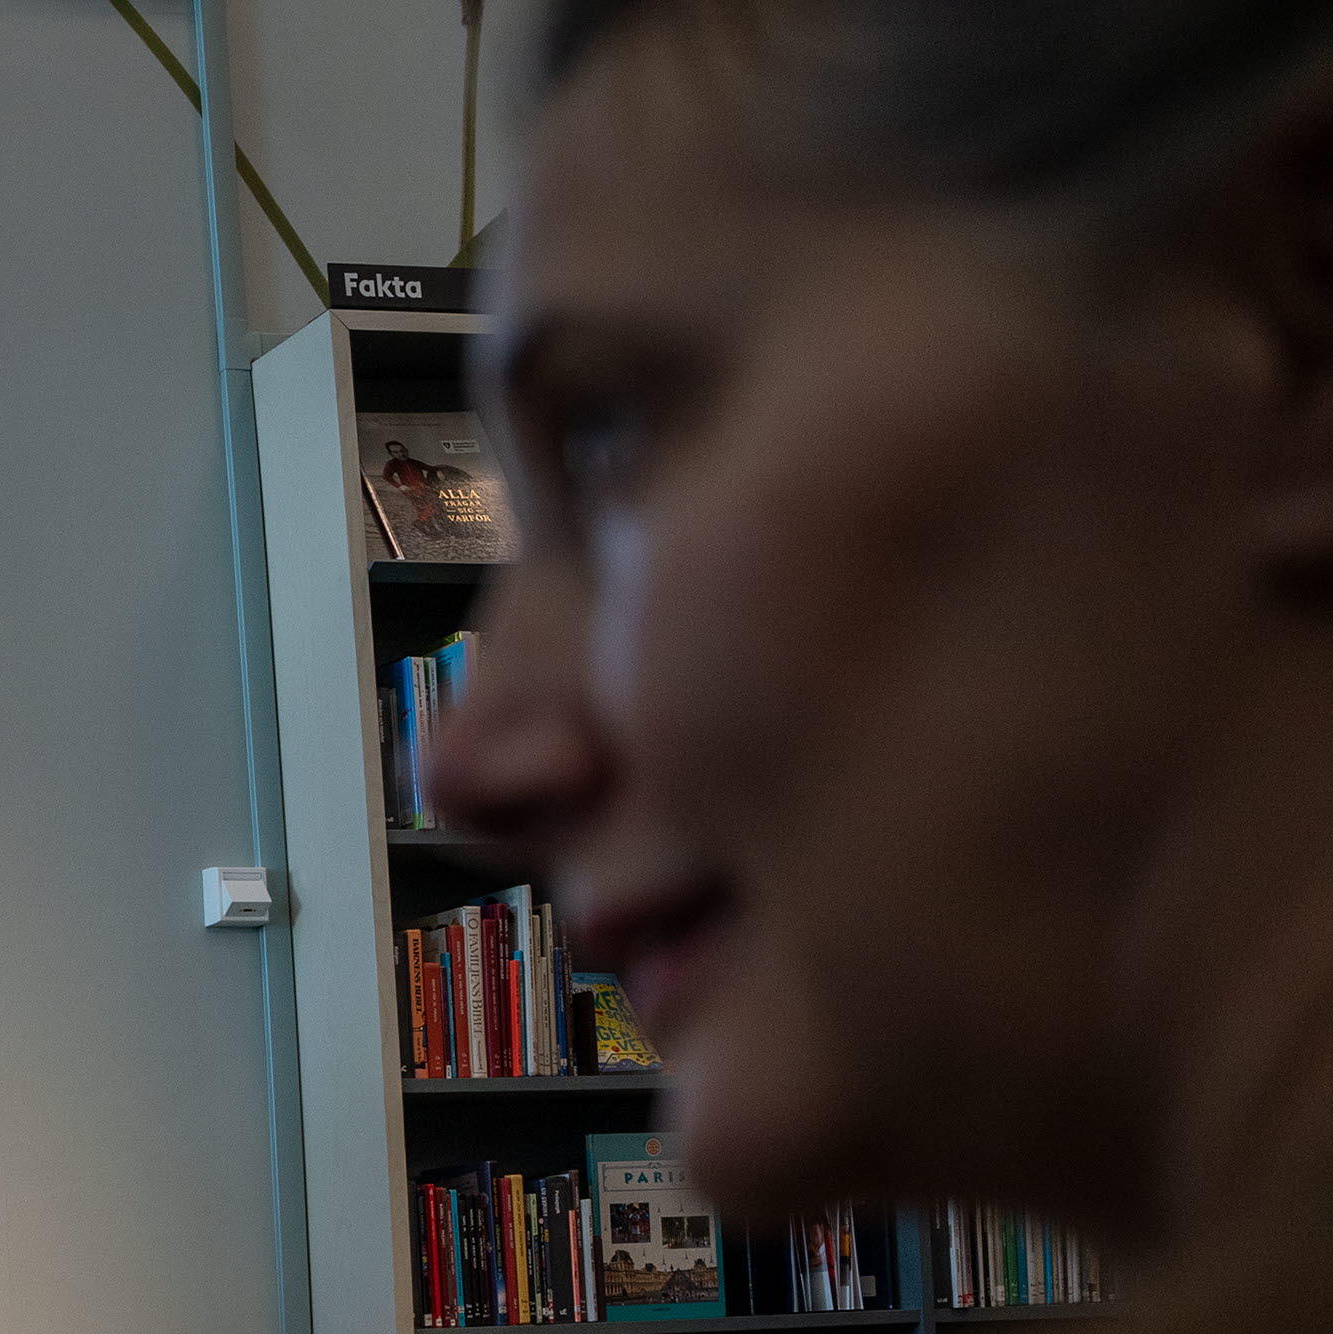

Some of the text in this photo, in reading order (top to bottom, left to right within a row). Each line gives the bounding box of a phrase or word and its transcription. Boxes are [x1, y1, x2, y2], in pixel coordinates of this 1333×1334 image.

[343, 272, 423, 299] Fakta
[438, 489, 481, 499] ALLA
[412, 938, 423, 1014] BARNENS BIBEL
[467, 931, 482, 998] FAMILJENS
[472, 999, 483, 1039] BIBEL
